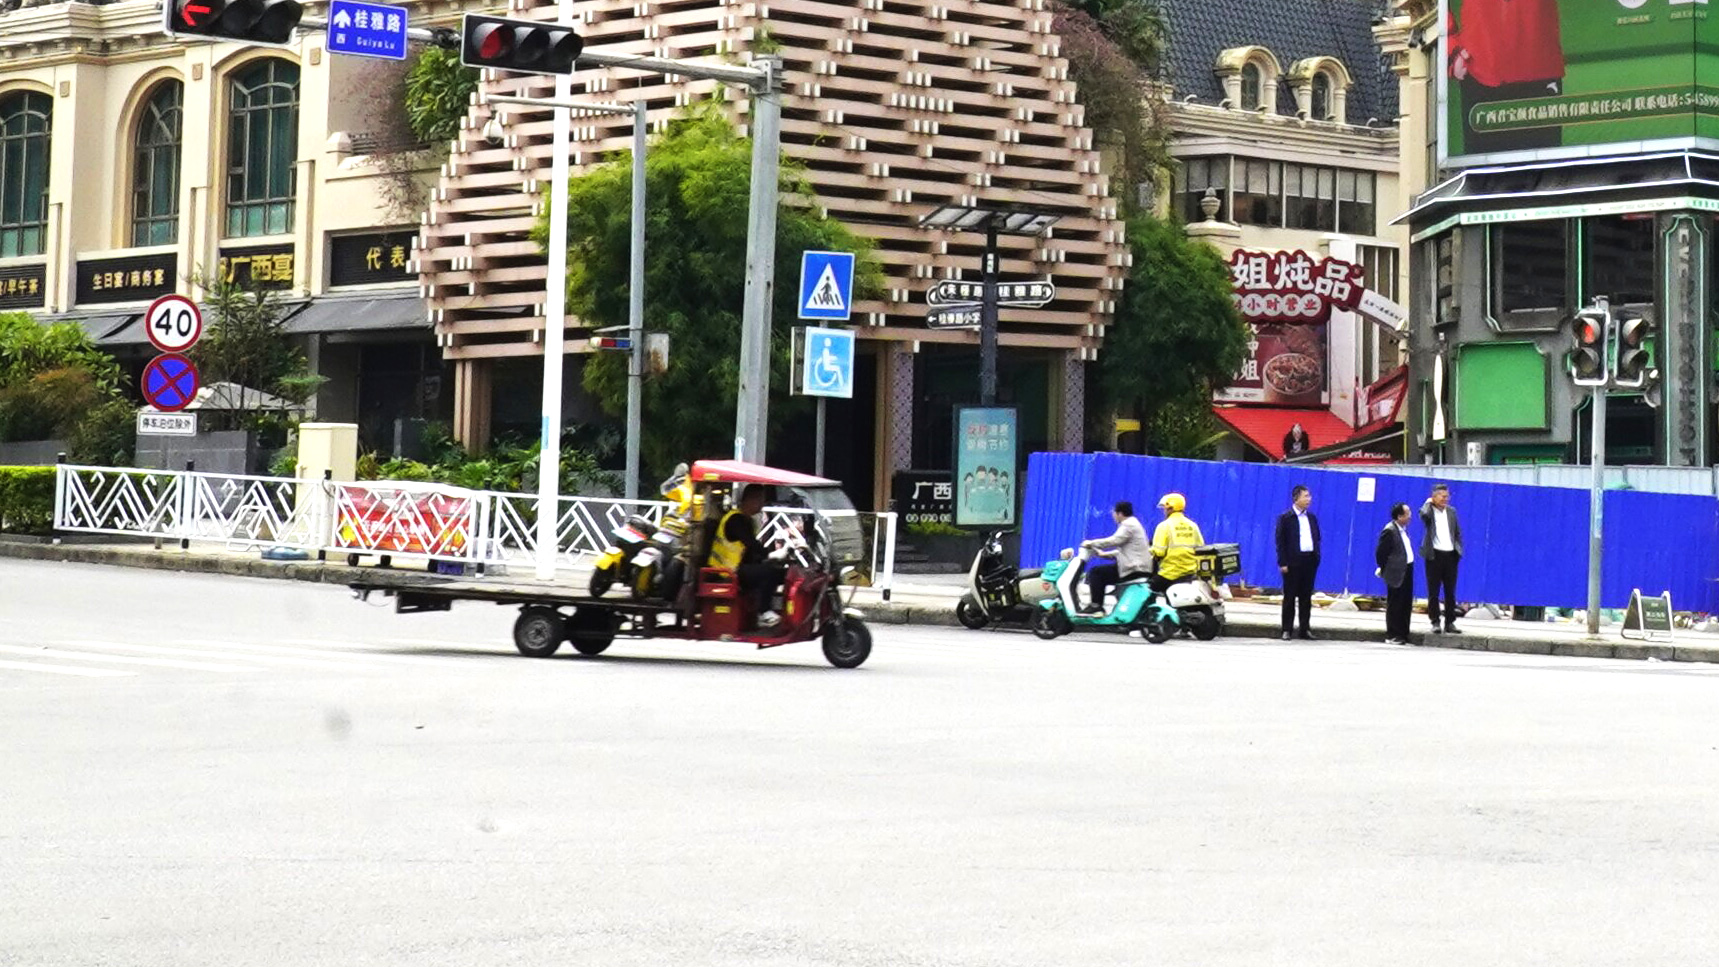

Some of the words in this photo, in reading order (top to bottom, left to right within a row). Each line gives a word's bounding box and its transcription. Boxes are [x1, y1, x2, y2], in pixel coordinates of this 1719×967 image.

[354, 9, 401, 33] 桂雅路
[226, 253, 294, 283] 广西宴
[1232, 253, 1352, 302] 姐炖品
[0, 277, 39, 297] /早午茶
[1232, 294, 1322, 317] 4小时营业
[155, 308, 192, 337] 40
